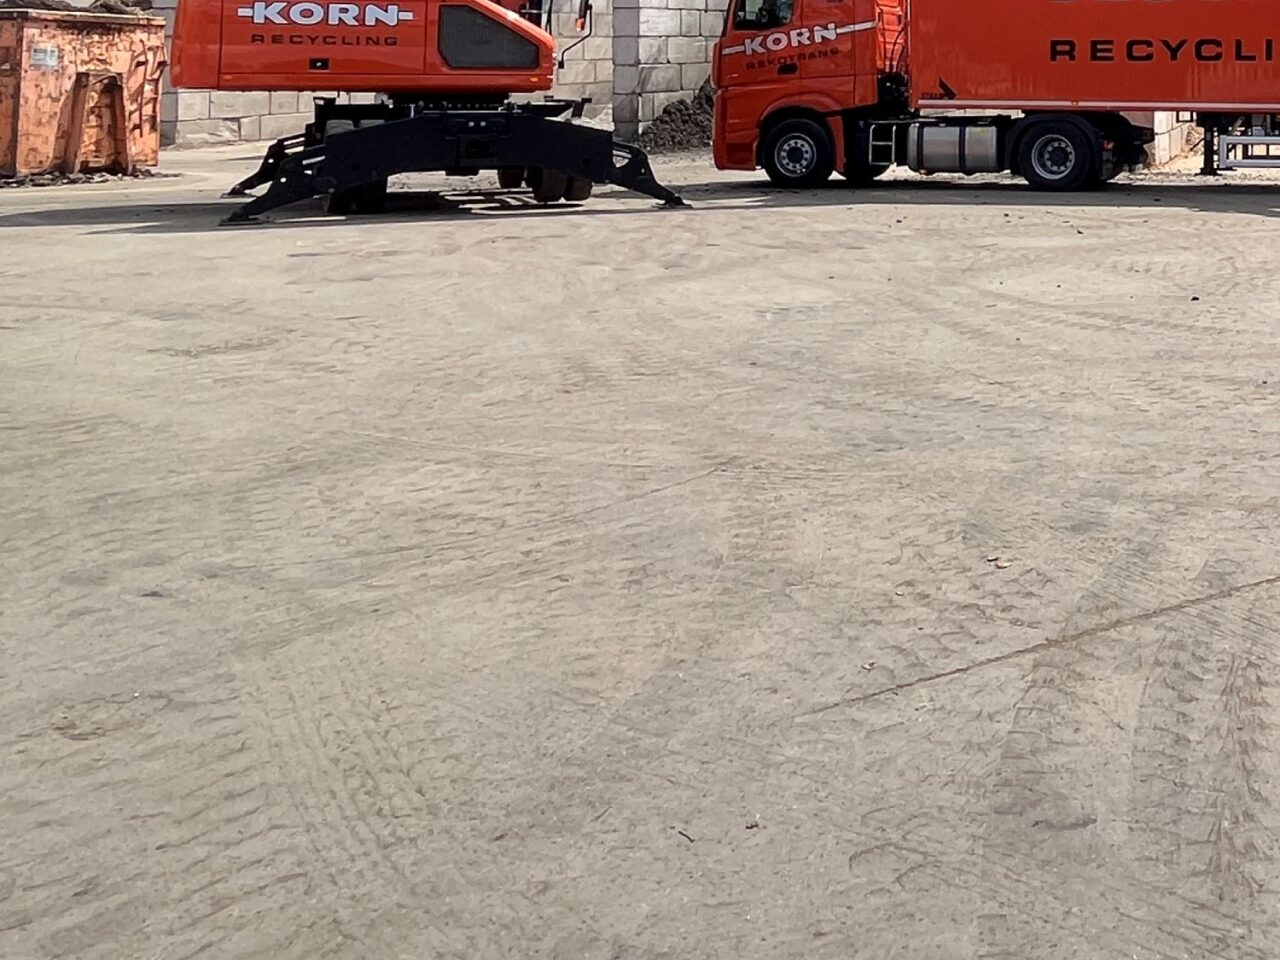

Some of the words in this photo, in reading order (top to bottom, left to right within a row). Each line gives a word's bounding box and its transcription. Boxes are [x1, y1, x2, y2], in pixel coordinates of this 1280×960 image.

[253, 1, 398, 26] KORN
[250, 34, 399, 46] RECYCLING
[744, 23, 837, 55] KORN
